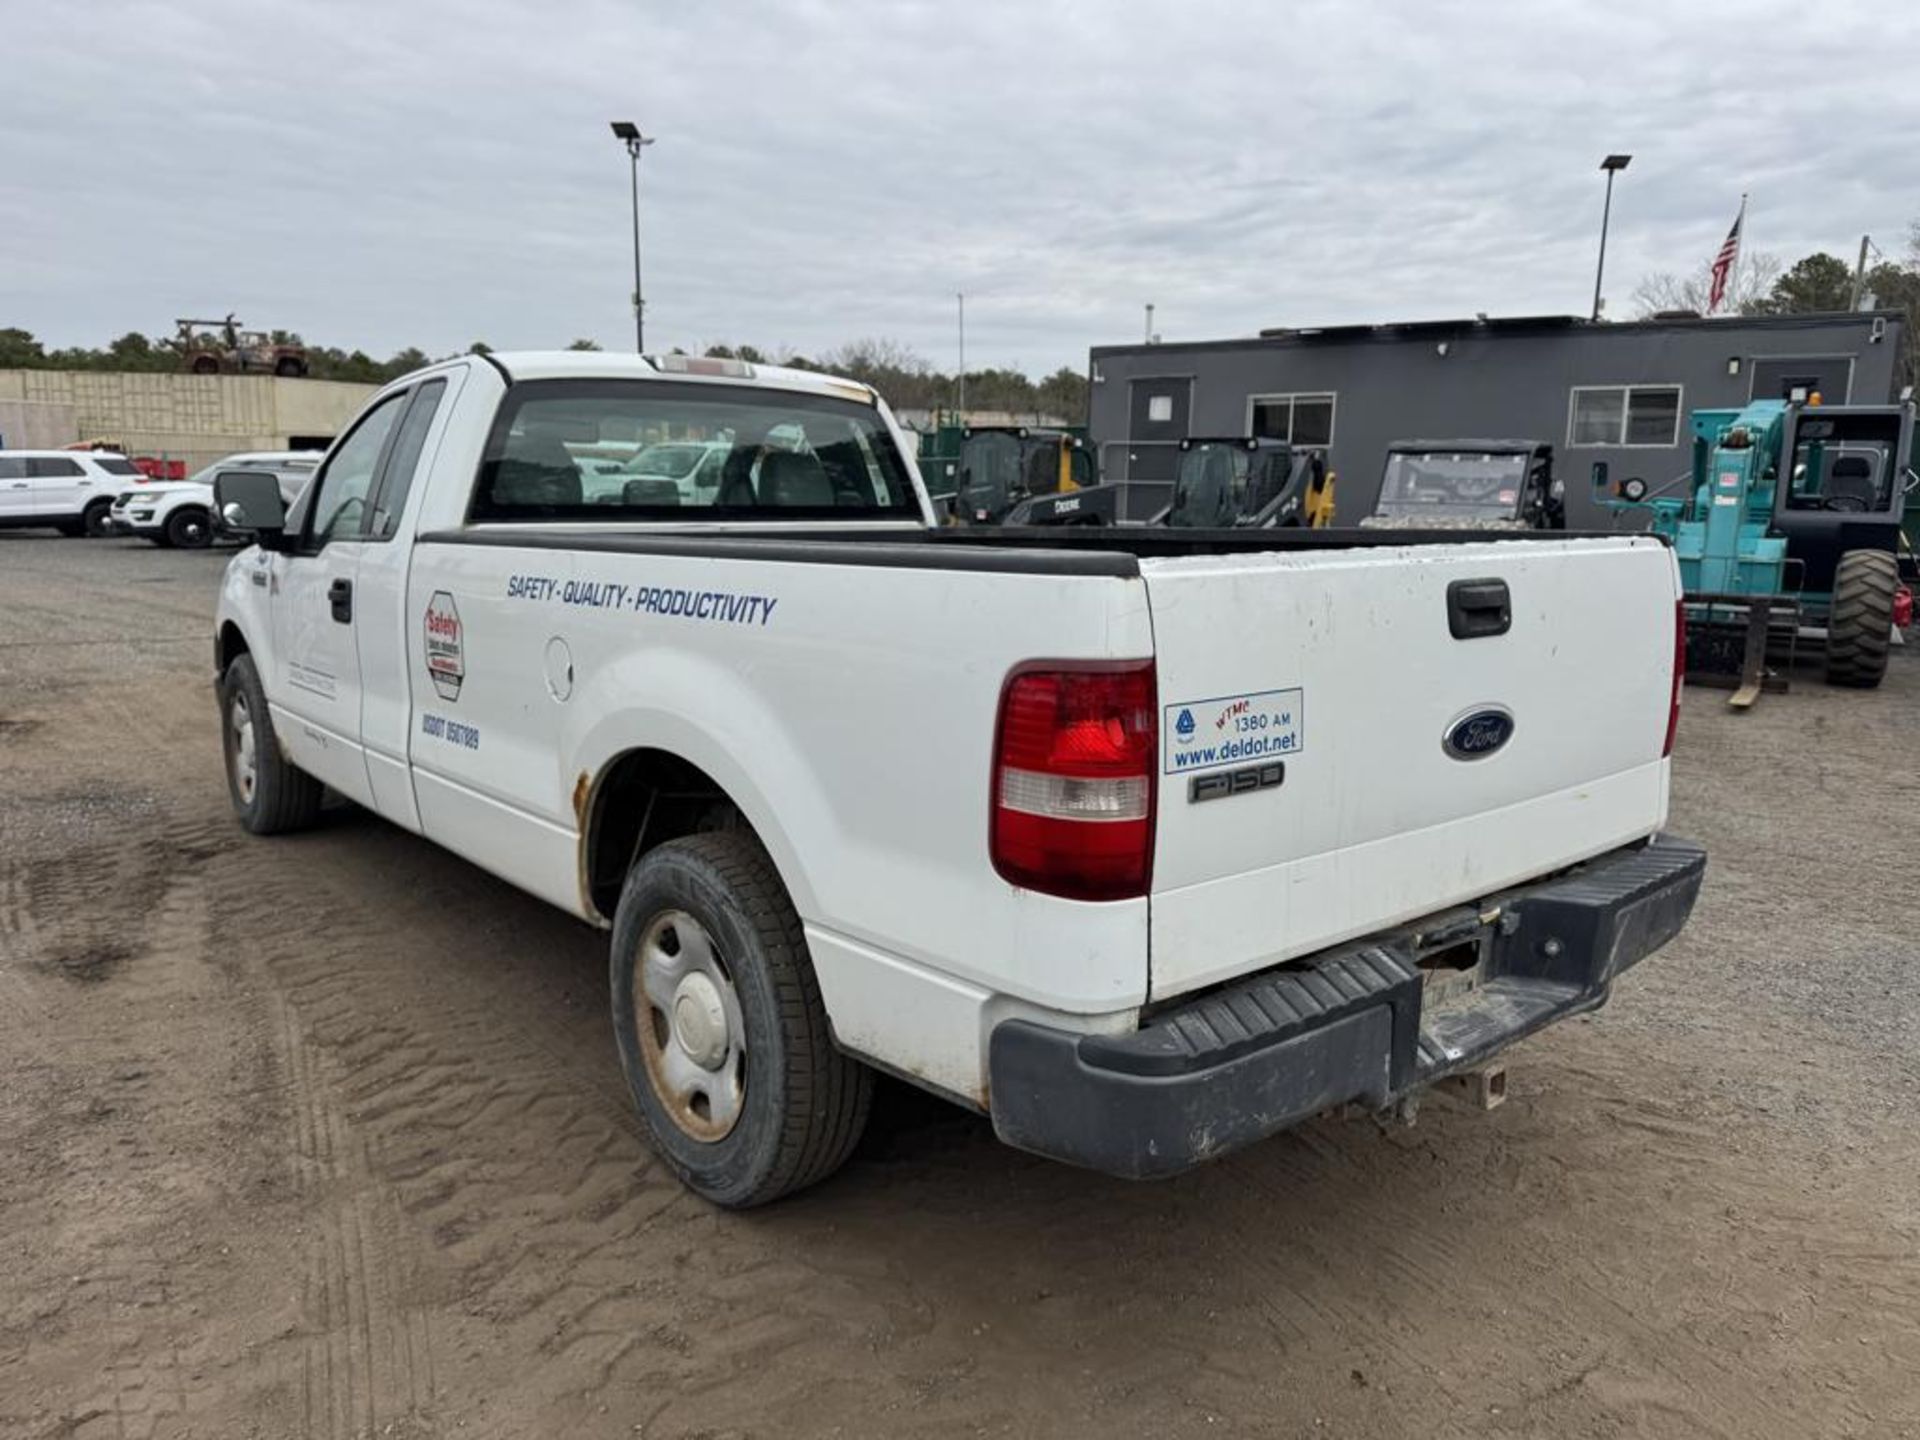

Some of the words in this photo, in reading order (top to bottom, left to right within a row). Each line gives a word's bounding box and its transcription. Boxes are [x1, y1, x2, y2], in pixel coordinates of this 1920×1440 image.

[1055, 499, 1080, 515] DEERE
[507, 575, 556, 601] SAFETY
[563, 580, 628, 609] QUALITY
[635, 587, 778, 627] PRODUCTIVITY
[427, 609, 458, 642] Safety
[1215, 700, 1250, 730] WTMC
[1235, 714, 1268, 733] 1380
[1273, 712, 1291, 727] AM
[1174, 731, 1297, 767] www.deldot.net
[1463, 719, 1504, 749] Ford
